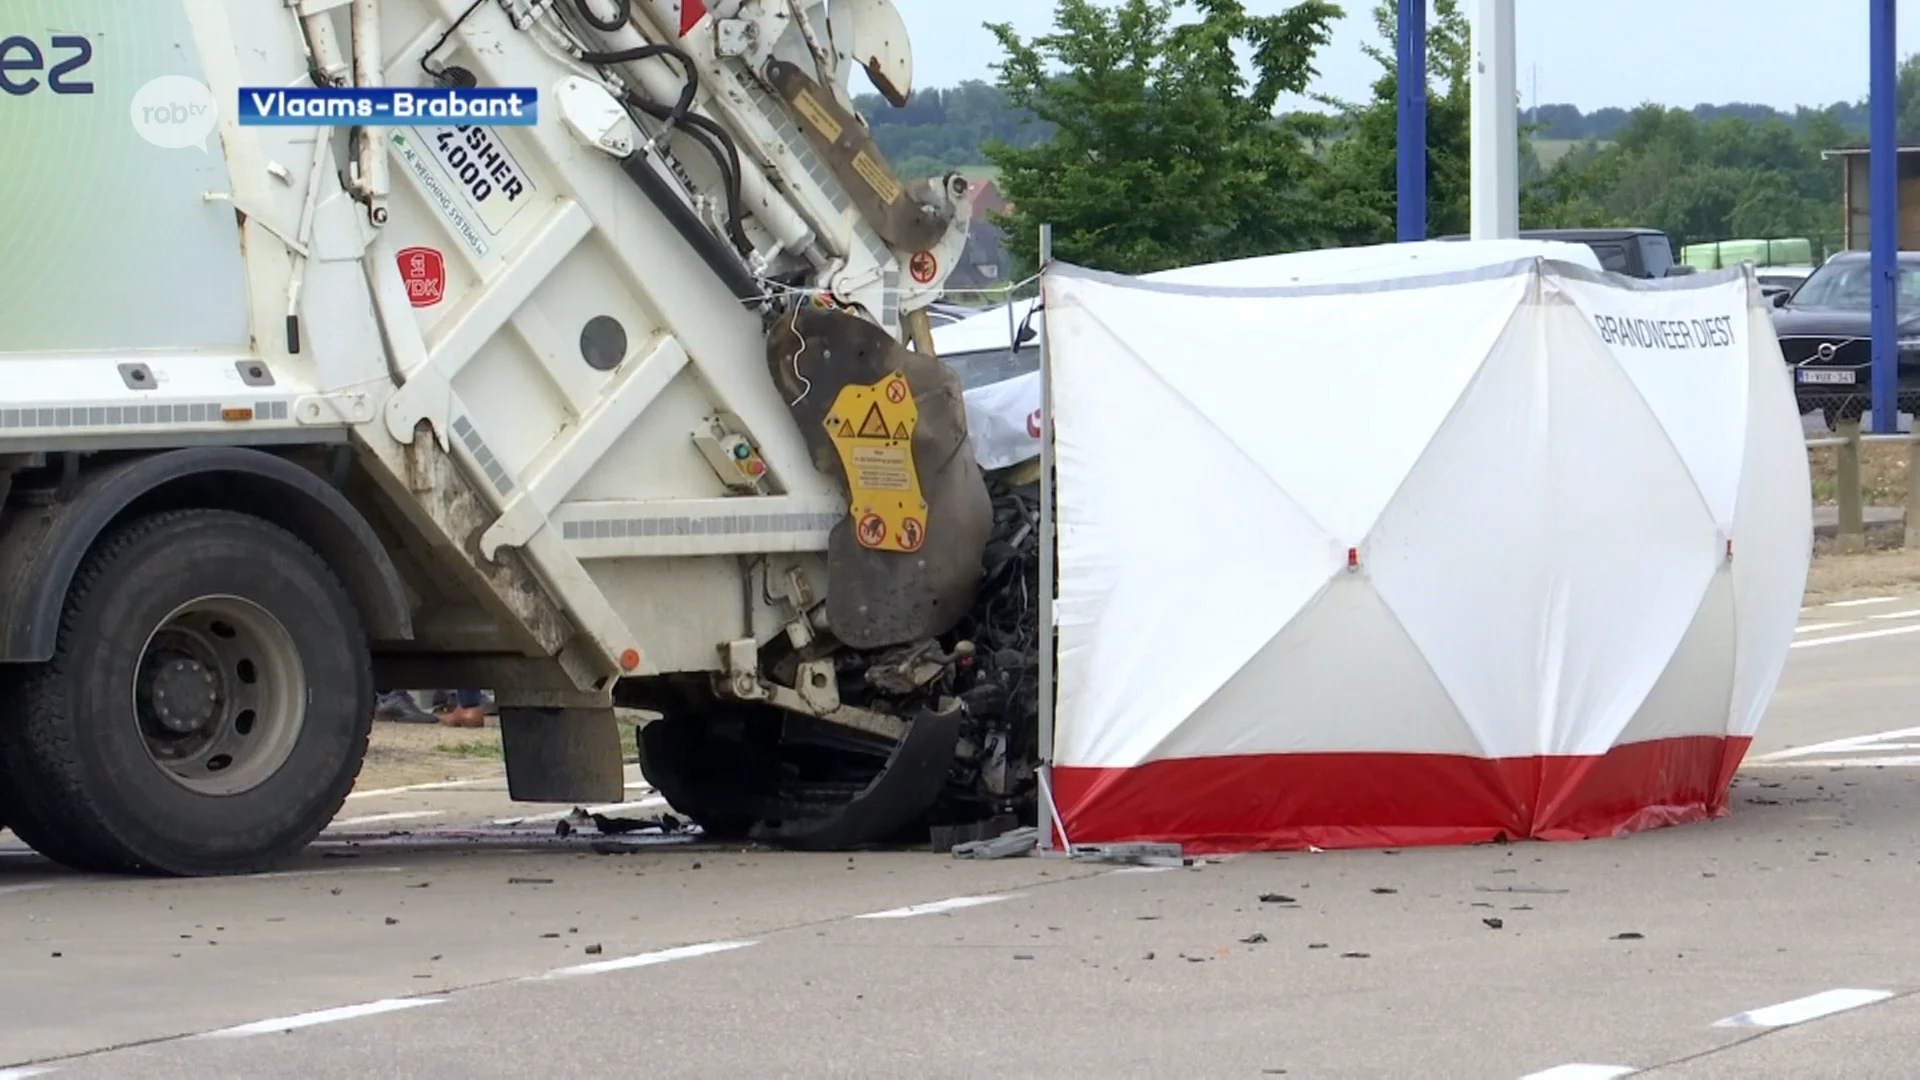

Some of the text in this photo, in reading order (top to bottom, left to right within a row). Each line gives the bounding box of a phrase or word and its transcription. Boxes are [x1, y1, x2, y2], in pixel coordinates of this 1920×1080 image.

[437, 131, 492, 202] 4000
[414, 161, 450, 209] WEIGHING
[448, 207, 480, 246] SYSTEMS
[1594, 314, 1736, 349] BRANDWEER DIEST
